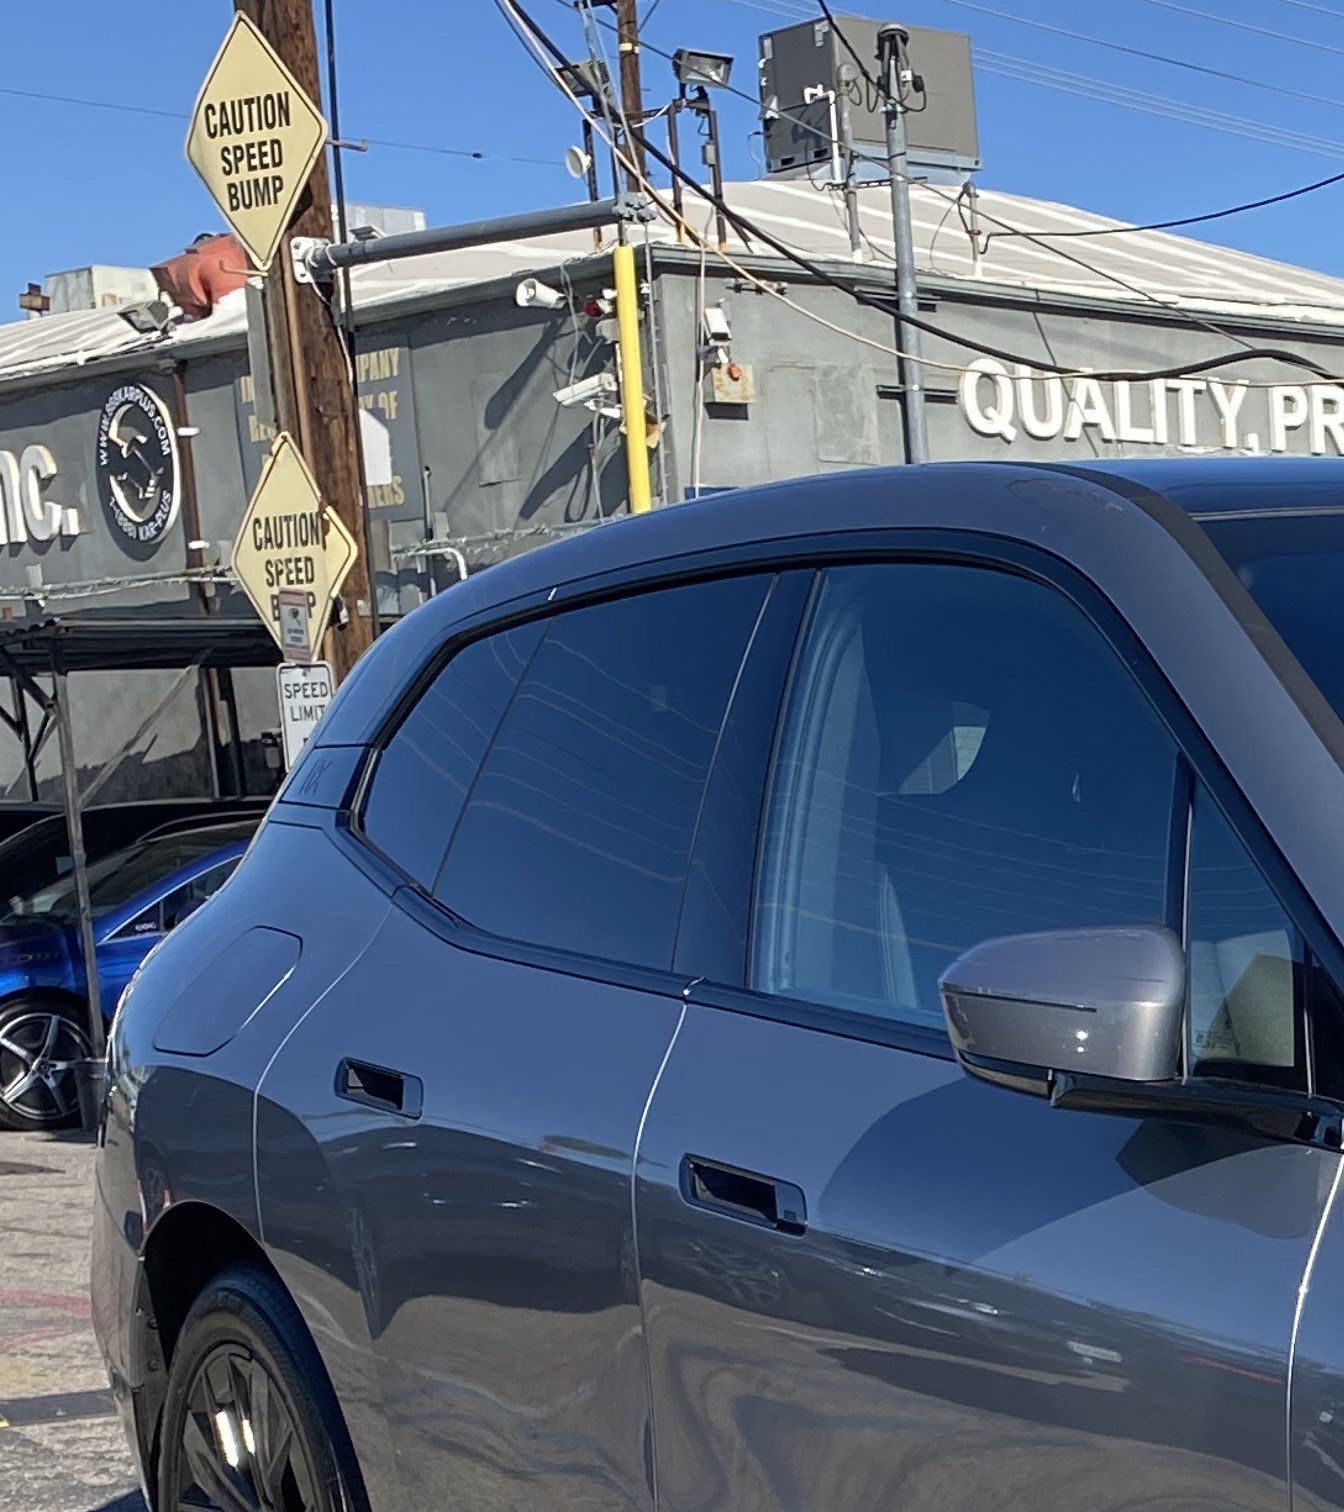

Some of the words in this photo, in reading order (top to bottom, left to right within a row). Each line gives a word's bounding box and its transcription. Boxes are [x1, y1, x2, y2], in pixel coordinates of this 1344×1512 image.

[204, 91, 291, 139] CAUTION
[221, 139, 283, 176] SPEED
[227, 175, 284, 212] BUMP
[958, 358, 1260, 453] QUALITY,
[253, 511, 321, 551] CAUTION
[265, 556, 315, 588] SPEED
[270, 591, 316, 622] BP
[284, 682, 328, 699] SPEED
[290, 704, 325, 721] LIMIT
